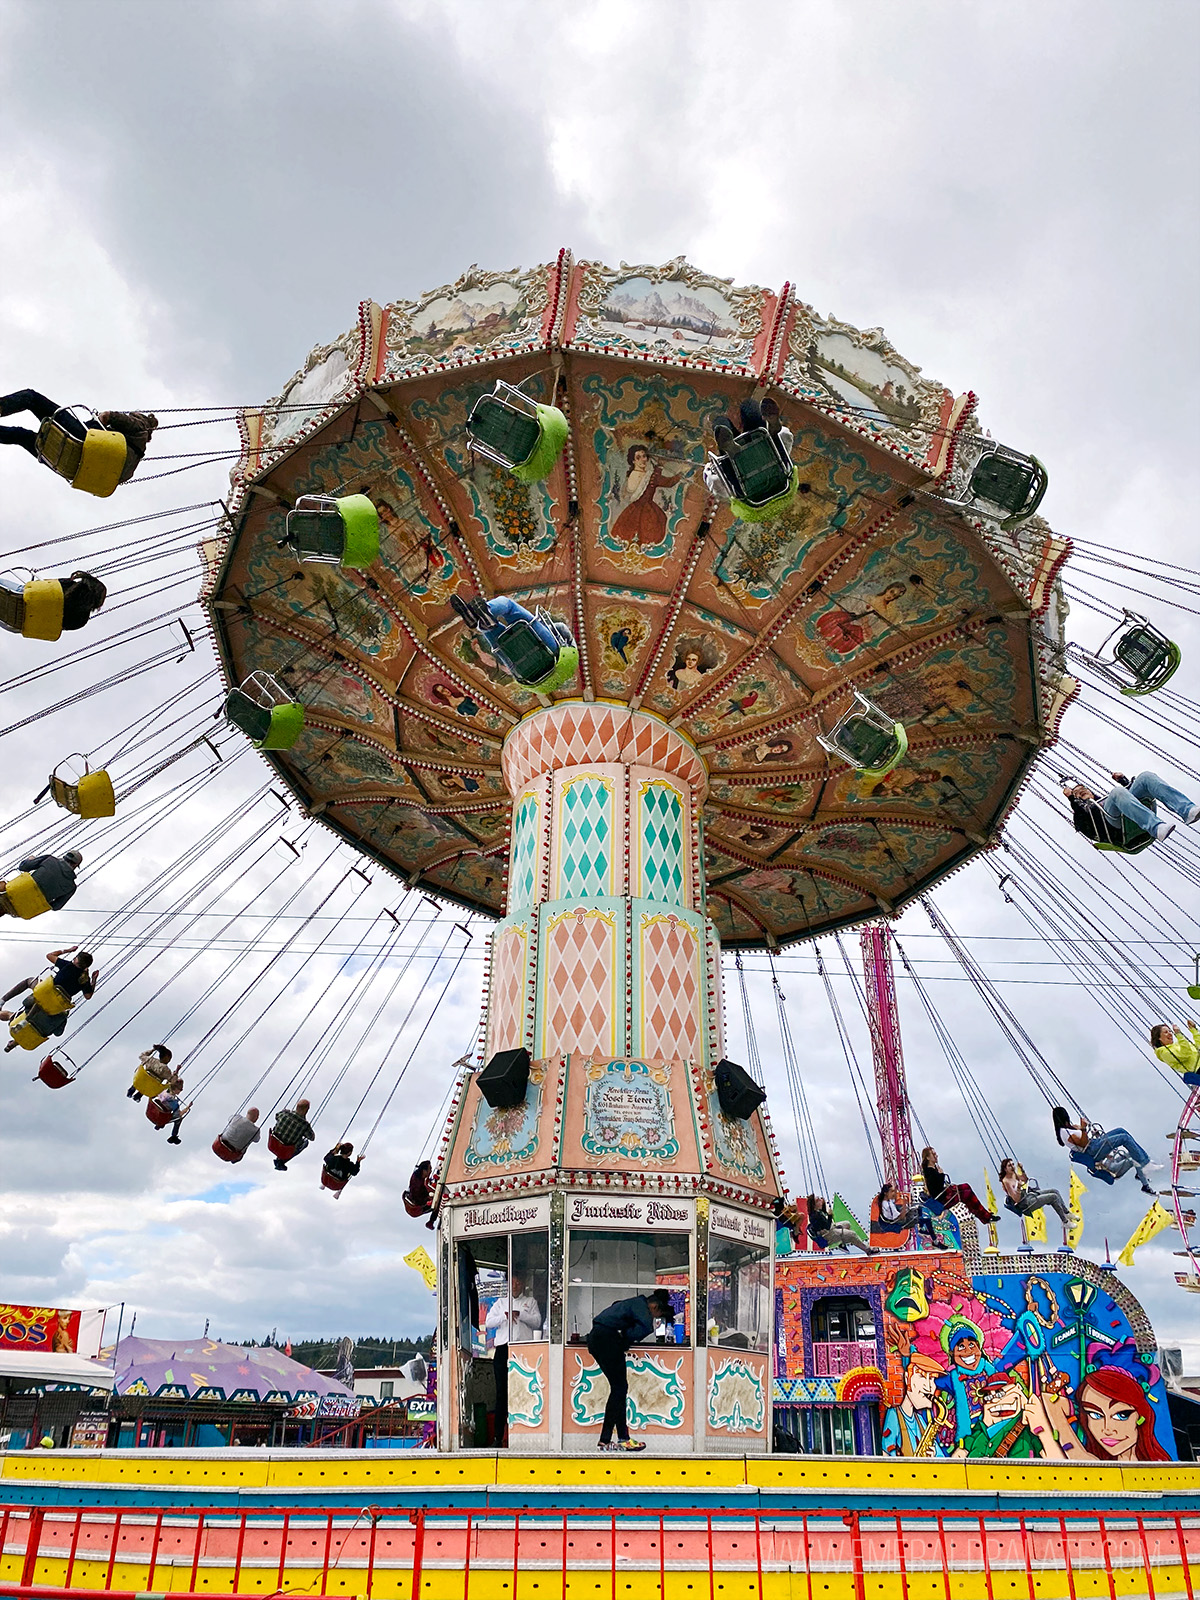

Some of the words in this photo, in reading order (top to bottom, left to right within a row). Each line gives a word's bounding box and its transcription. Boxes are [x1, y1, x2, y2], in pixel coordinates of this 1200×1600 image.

[603, 1093, 623, 1103] Josef
[627, 1095, 653, 1103] Zierer
[571, 1198, 643, 1222] Funtastic
[646, 1201, 689, 1225] Rides
[0, 1321, 48, 1345] OS
[1058, 1327, 1076, 1342] CANAL
[409, 1401, 435, 1411] EXIT
